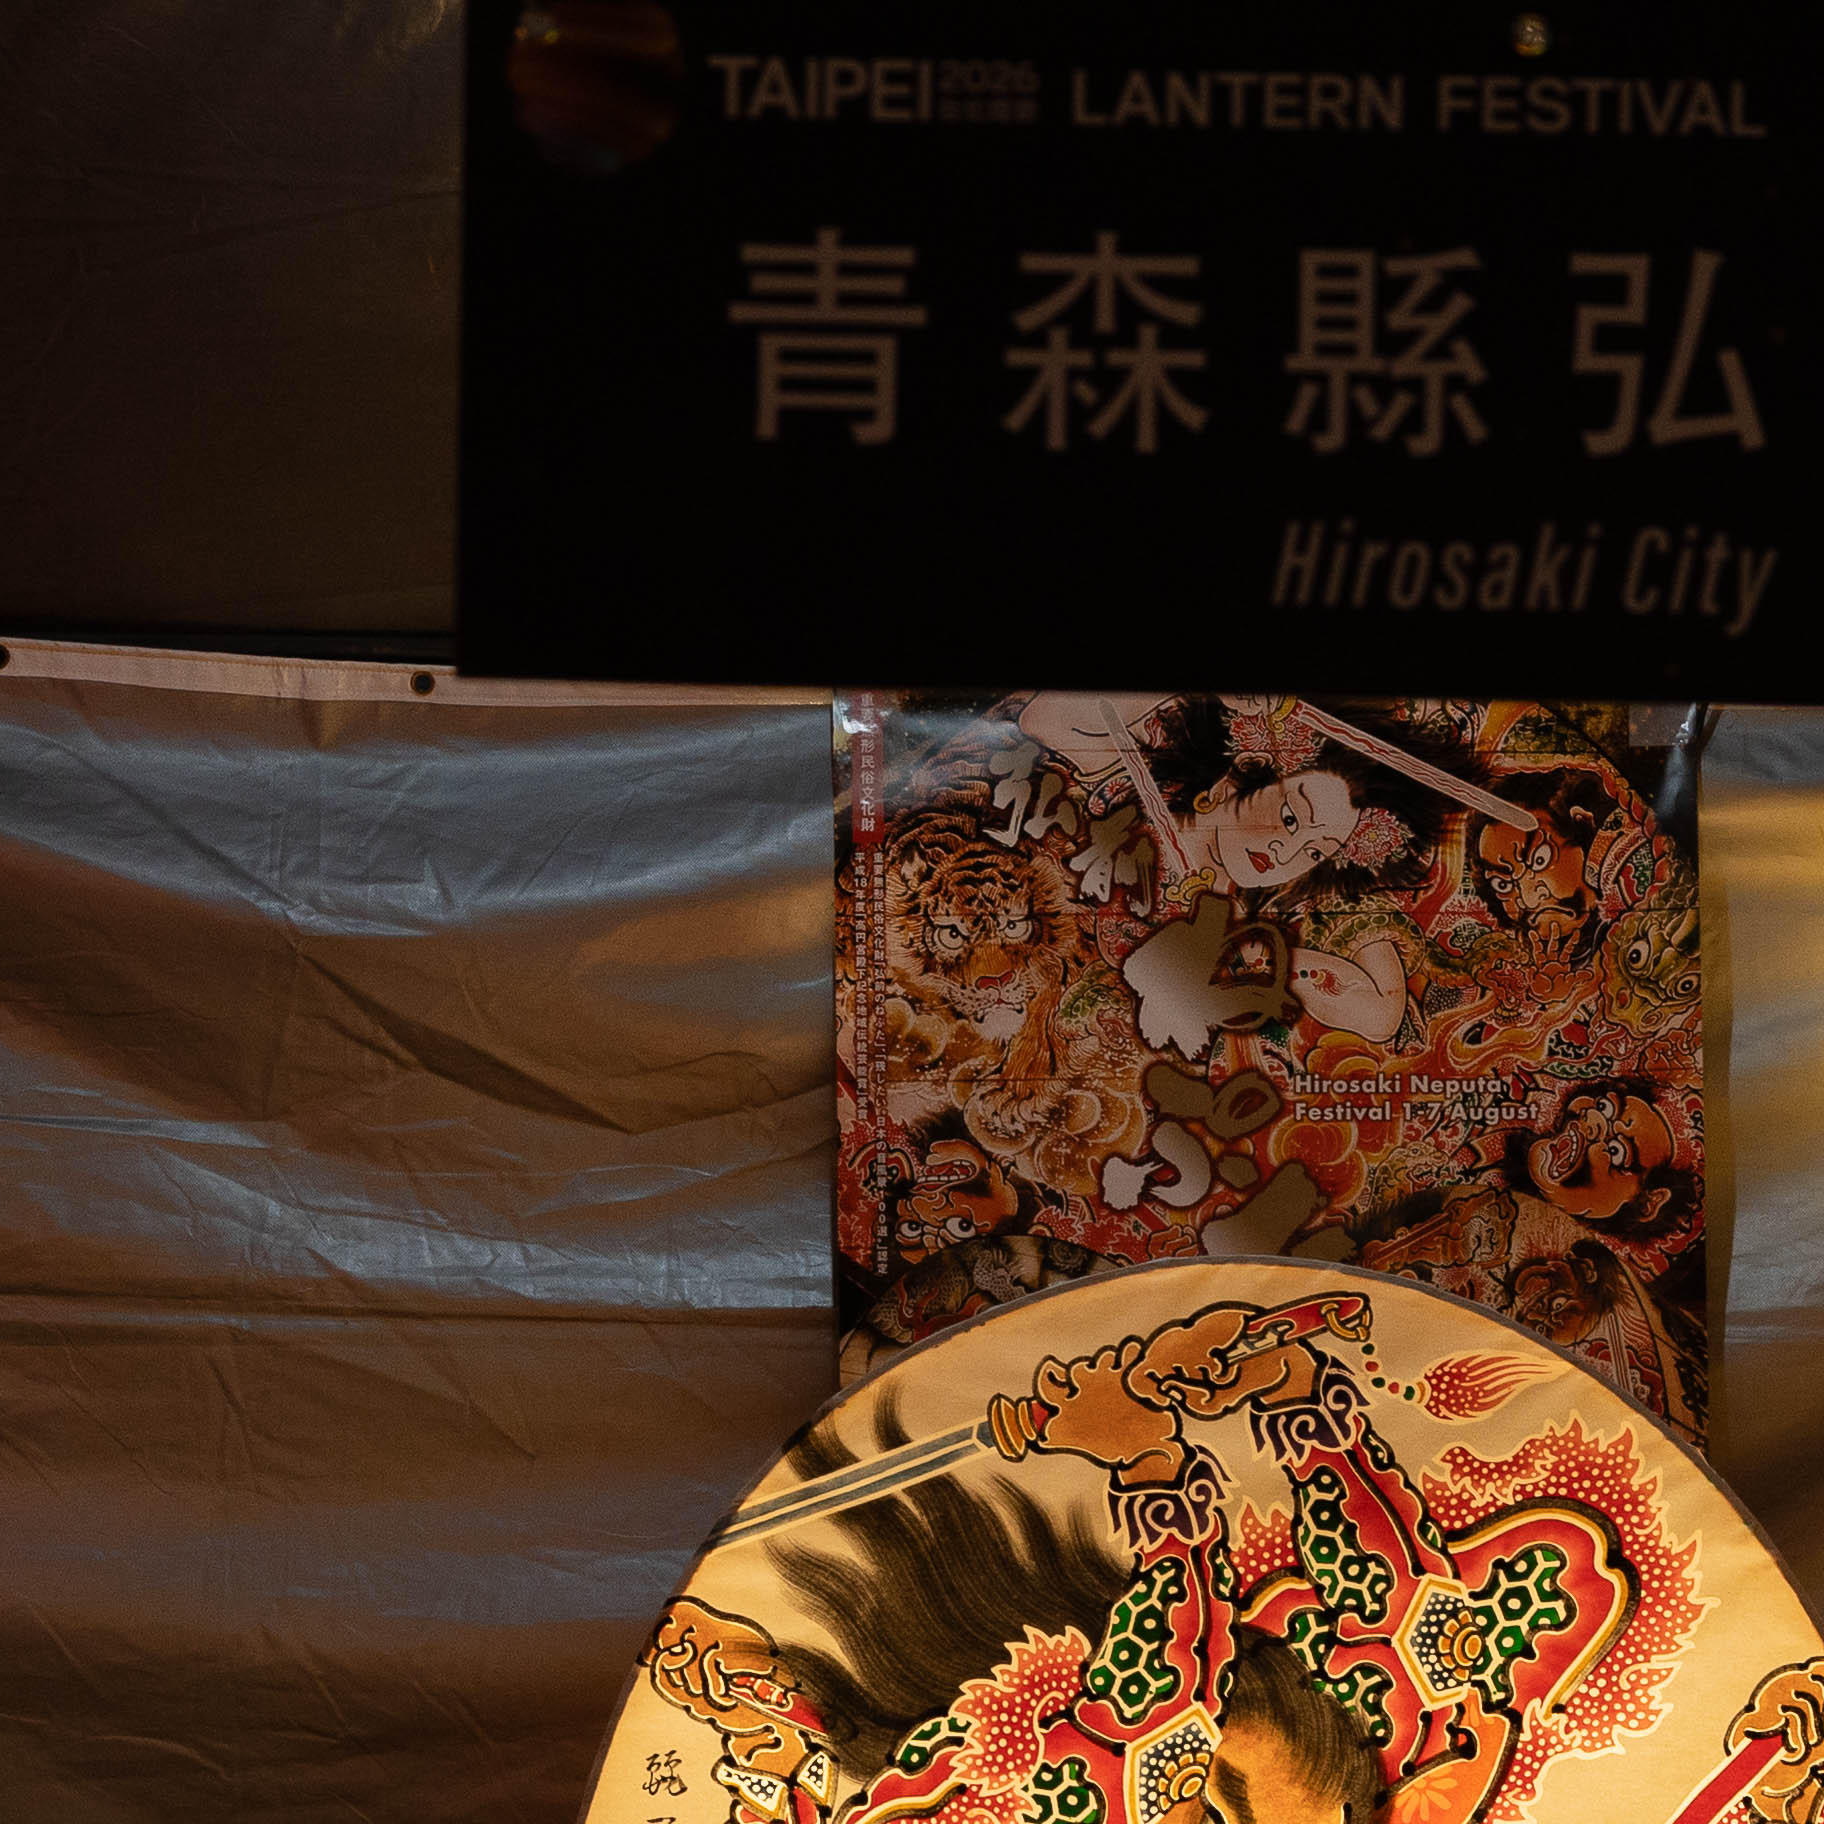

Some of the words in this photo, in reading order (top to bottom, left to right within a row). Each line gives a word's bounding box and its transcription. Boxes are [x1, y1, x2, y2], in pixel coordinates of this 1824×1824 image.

[705, 53, 936, 123] TAIPEI
[1071, 66, 1408, 134] LANTERN
[1433, 73, 1769, 139] FESTIVAL
[1271, 518, 1600, 616] Hirosaki
[1620, 526, 1776, 638] City
[859, 692, 876, 834] 重要形民俗文化財
[1295, 1073, 1402, 1095] Hirosaki
[1410, 1075, 1503, 1098] Neputa
[1295, 1102, 1393, 1122] Festival
[1403, 1103, 1443, 1122] 1-7
[1450, 1103, 1541, 1126] August
